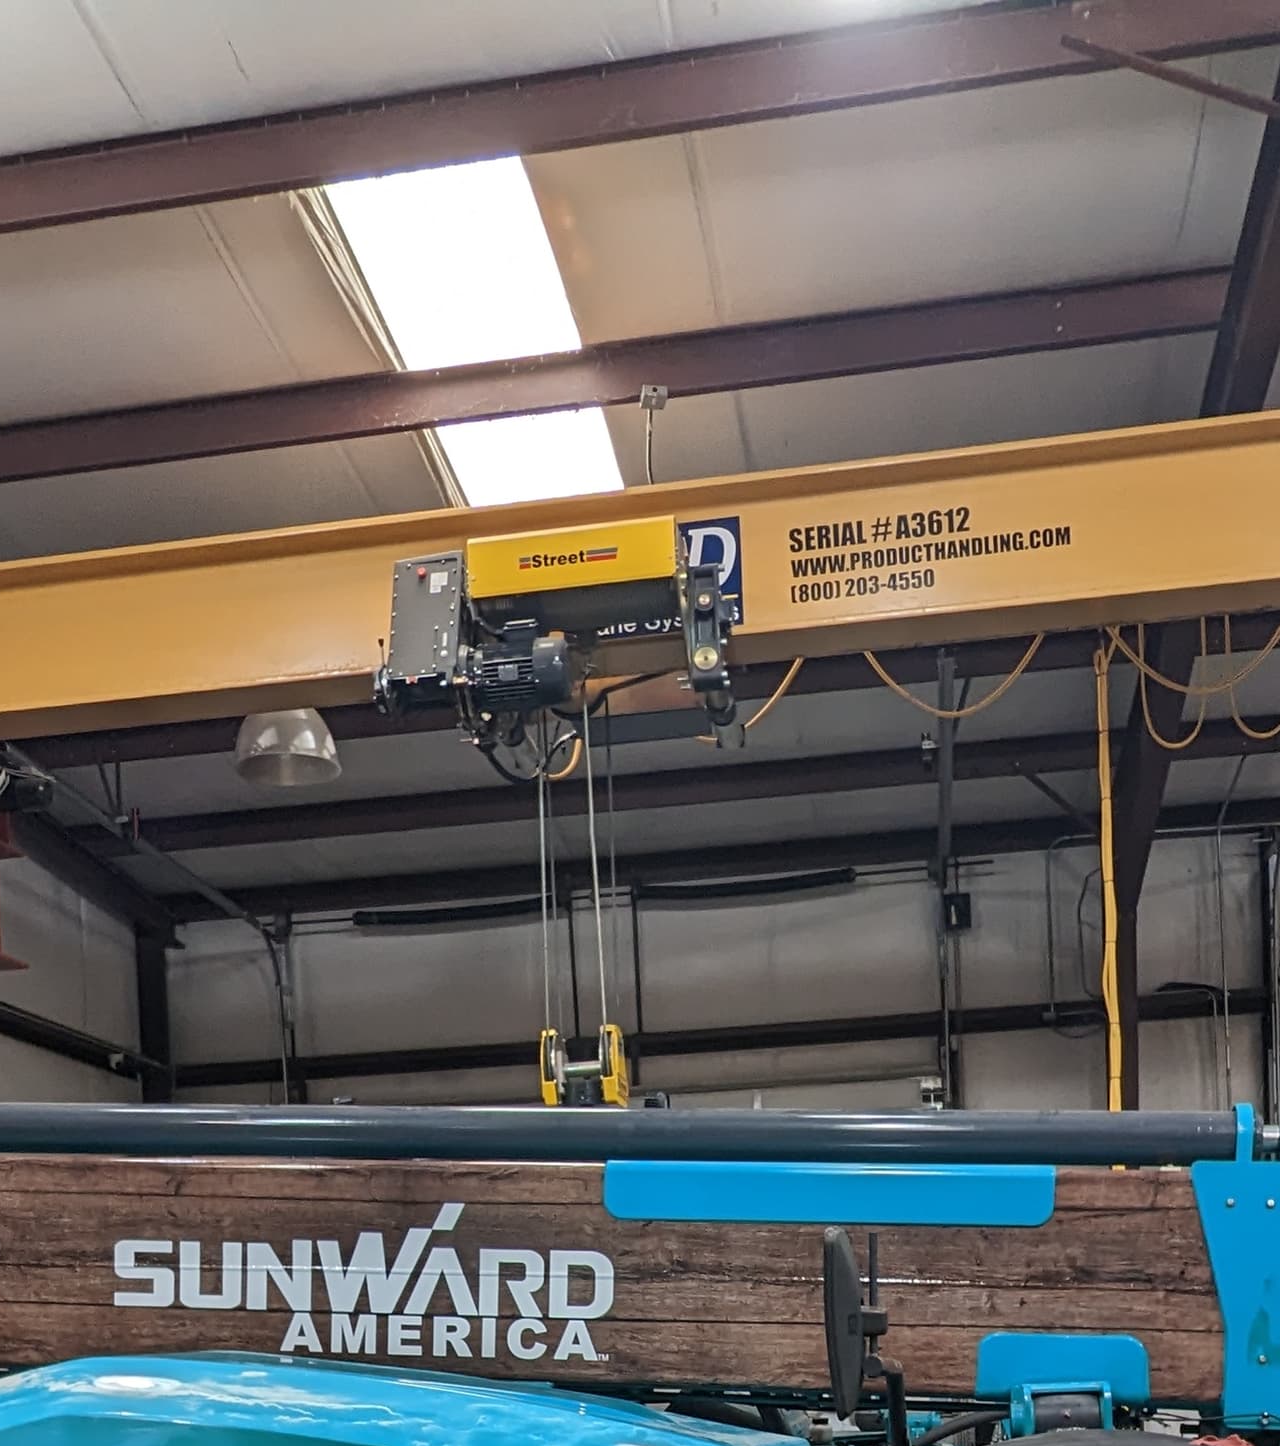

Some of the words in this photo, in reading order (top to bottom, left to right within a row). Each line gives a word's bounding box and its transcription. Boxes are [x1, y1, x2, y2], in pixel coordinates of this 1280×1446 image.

[789, 520, 867, 553] SERIAL
[791, 526, 1072, 578] WWW.PRODUCTHANDLING.COM
[531, 550, 585, 568] Street
[791, 580, 841, 604] (800)
[845, 568, 935, 598] 203-4550
[114, 1202, 615, 1320] SUNWARD
[279, 1312, 598, 1361] AMERICA
